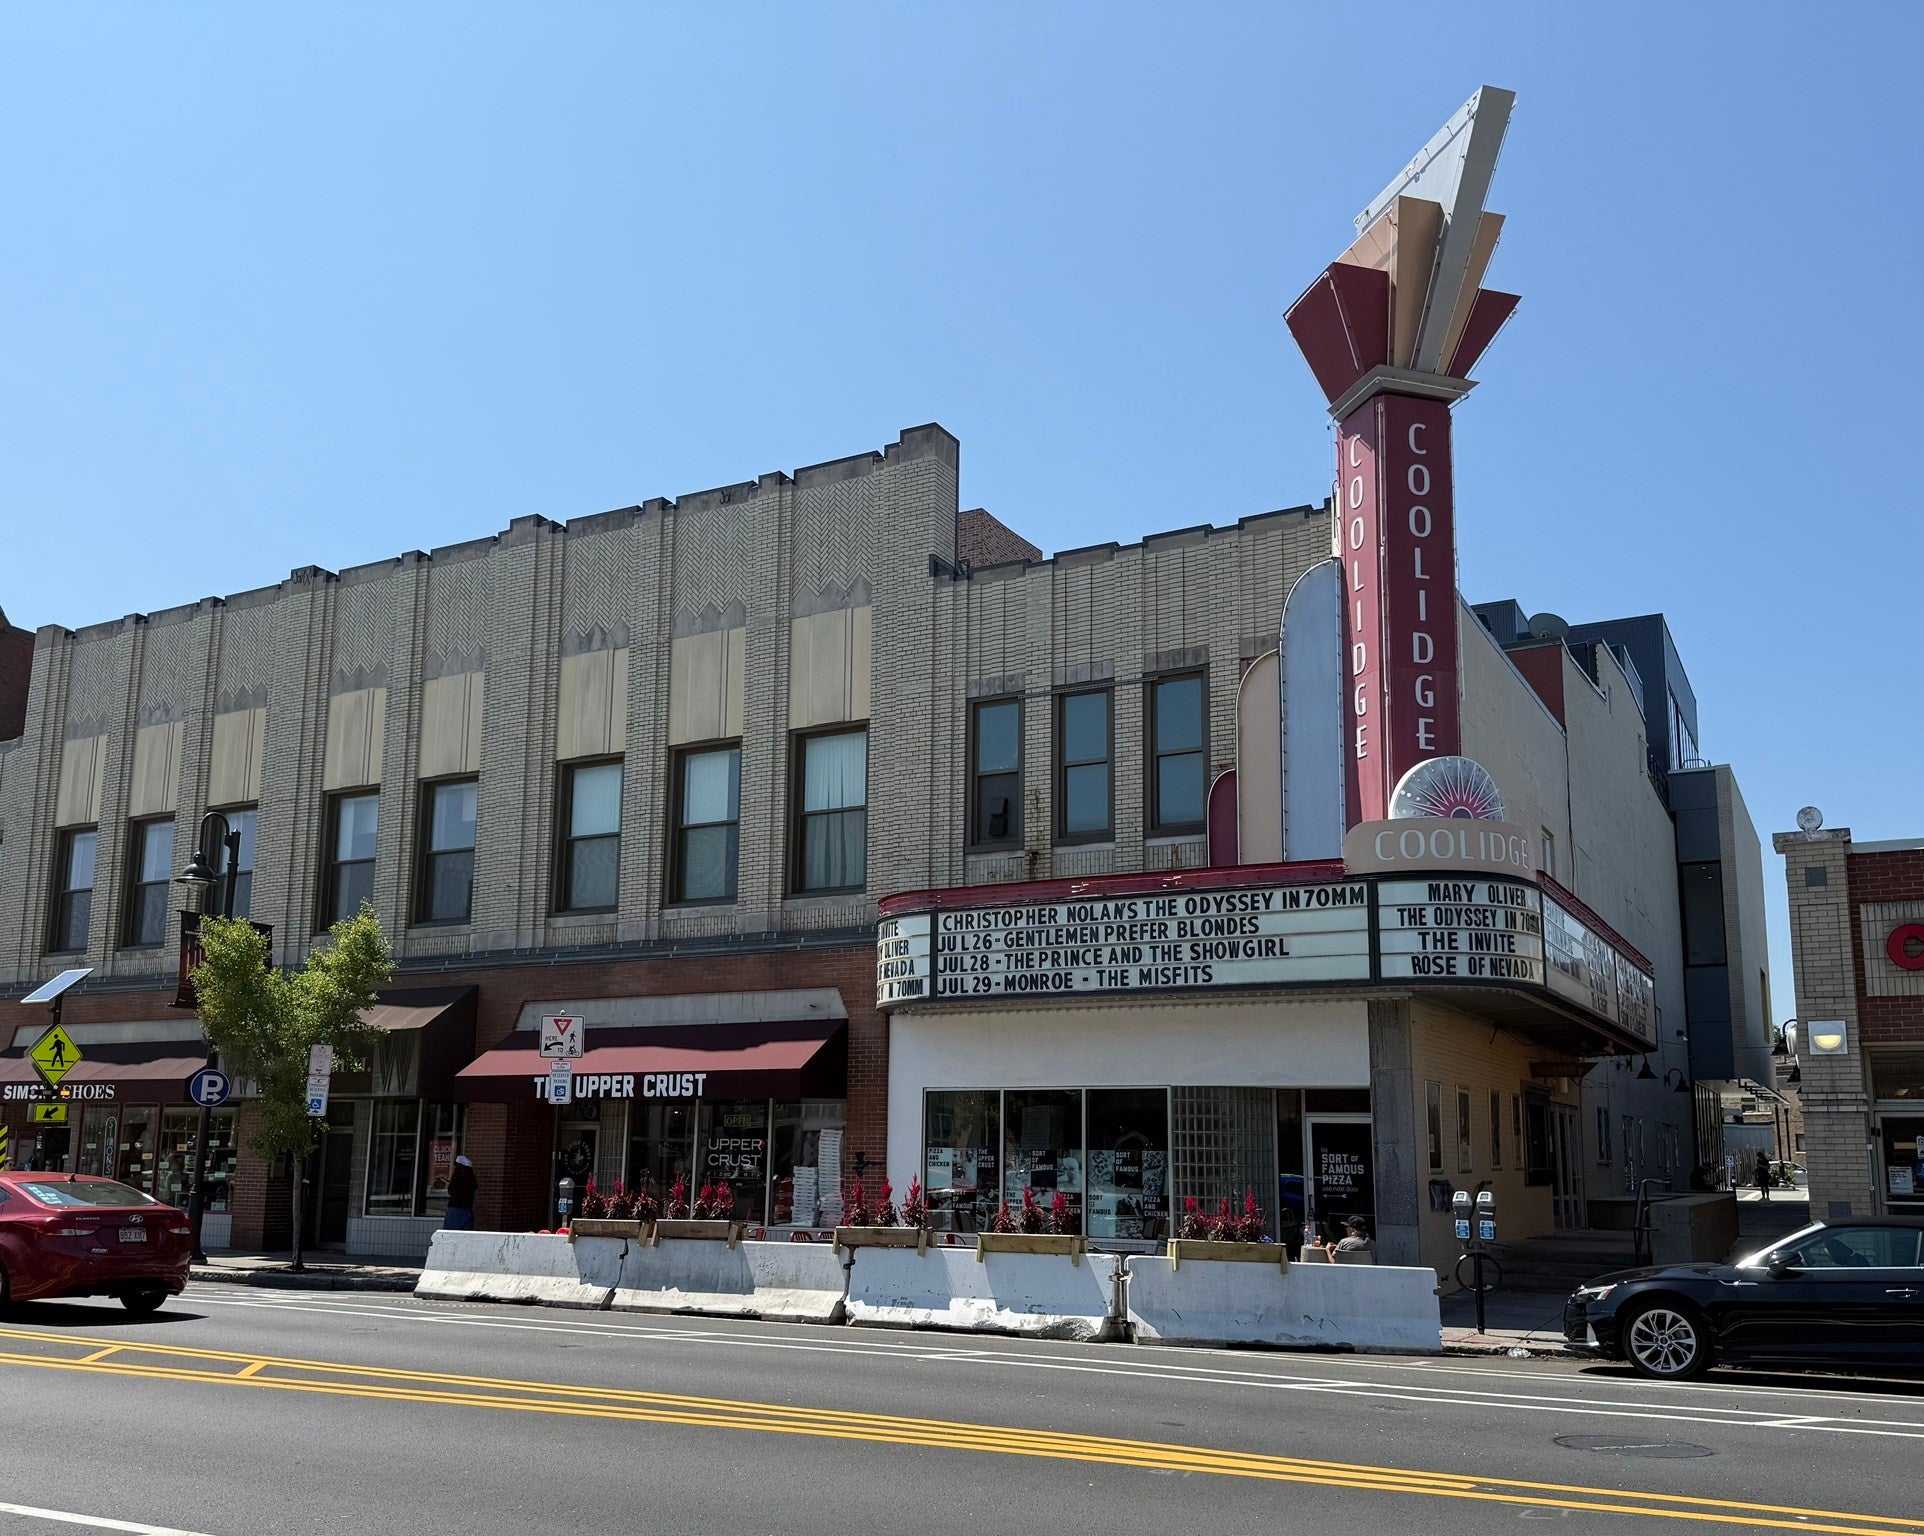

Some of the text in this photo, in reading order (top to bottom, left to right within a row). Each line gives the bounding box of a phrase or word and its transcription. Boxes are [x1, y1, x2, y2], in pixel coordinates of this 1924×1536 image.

[1349, 433, 1368, 759] COOLIDGE
[1407, 422, 1436, 751] COOLIDGE
[1374, 828, 1529, 870] COOLIDGE
[1427, 883, 1526, 908] MARY OLIVER
[942, 907, 1058, 932] CHRISTOPHER
[1067, 901, 1138, 923] NOLAN'S
[1143, 898, 1178, 917] THE
[1185, 891, 1274, 916] ODYSSEY
[1397, 907, 1426, 927] THE
[1433, 906, 1498, 928] ODYSSEY
[1504, 910, 1517, 930] IN
[937, 935, 969, 953] JUL
[1003, 926, 1099, 948] GENTLEMEN
[1104, 922, 1169, 942] PREFER
[1177, 915, 1260, 938] BLONDES
[1417, 931, 1516, 953] THE INVITE
[938, 956, 968, 974] JUL
[1004, 952, 1035, 970] THE
[1038, 948, 1103, 968] PRINCE
[1108, 946, 1143, 966] AND
[1149, 944, 1183, 963] THE
[1189, 938, 1290, 961] SHOWGIRL
[1410, 955, 1457, 975] ROSE
[1468, 956, 1486, 976] OF
[1489, 957, 1535, 980] NEVADA
[937, 977, 968, 995] JUL
[1004, 972, 1074, 992] MONROE
[1096, 969, 1130, 987] THE
[1139, 964, 1213, 986] MISFITS
[3, 1084, 58, 1100] SIMO
[575, 1075, 635, 1098] UPPER
[643, 1073, 707, 1098] CRUST
[708, 1138, 762, 1150] UPPER
[707, 1153, 761, 1166] CRUST
[1321, 1153, 1348, 1163] SORT
[1321, 1164, 1364, 1174] FAMOUS
[1322, 1174, 1353, 1185] PIZZA
